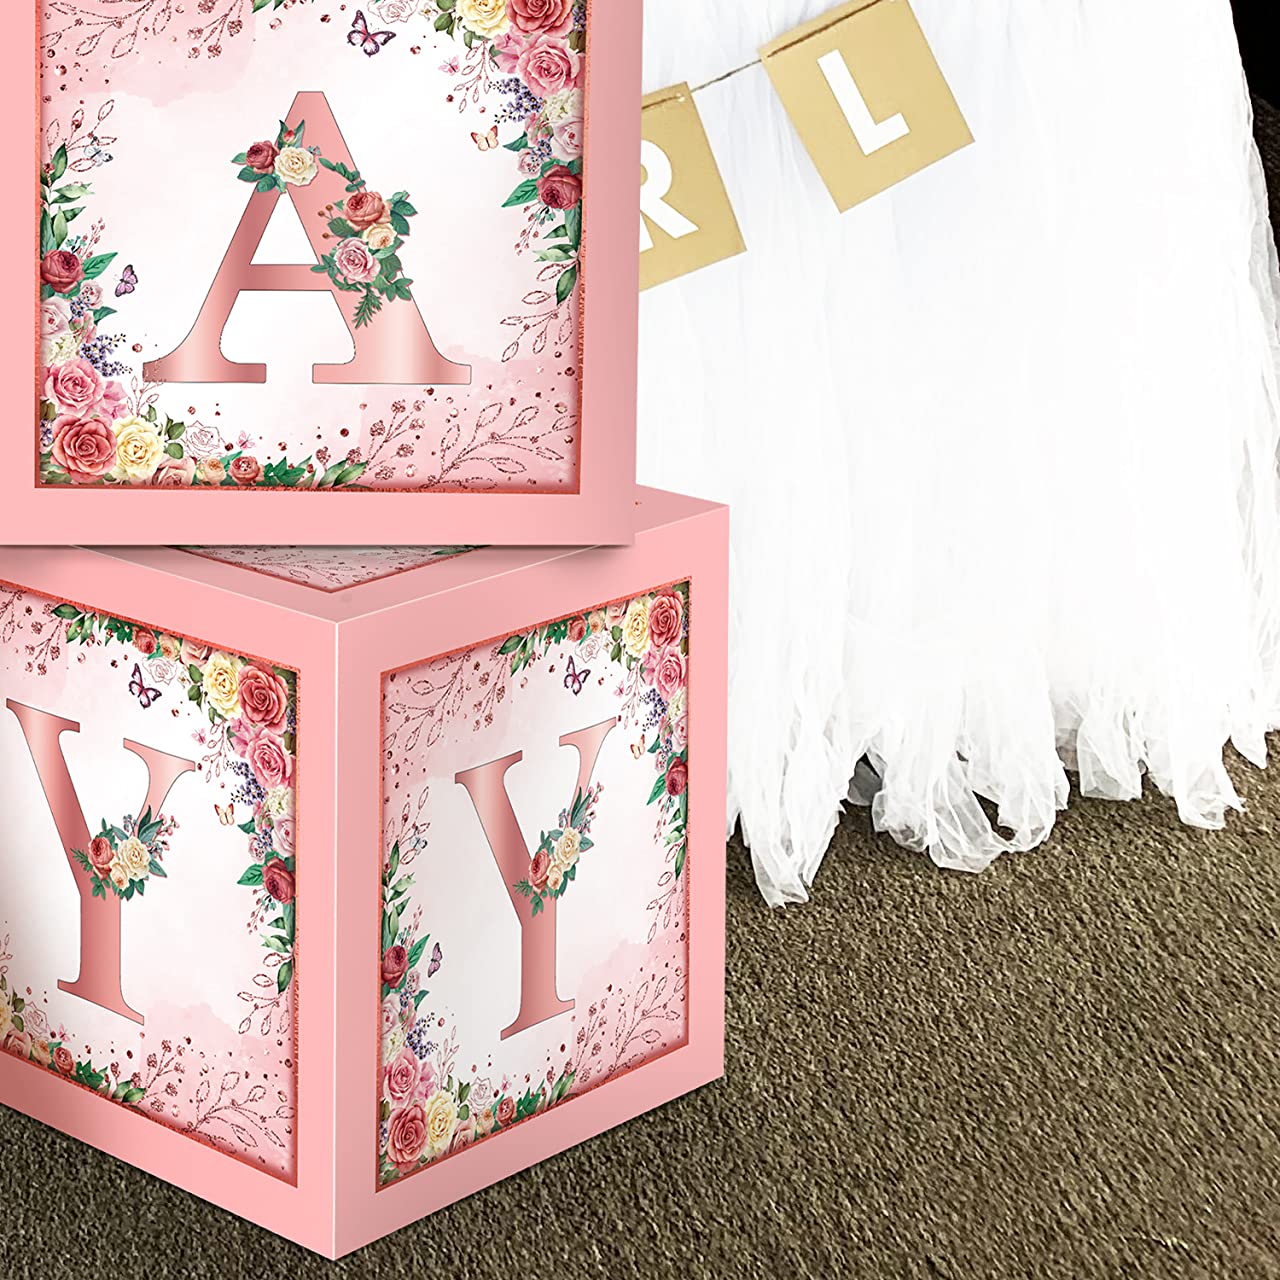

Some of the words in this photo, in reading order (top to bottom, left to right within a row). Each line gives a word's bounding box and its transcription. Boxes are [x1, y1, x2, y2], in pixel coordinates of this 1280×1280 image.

[142, 91, 471, 385] A
[6, 698, 196, 1026] Y
[455, 716, 617, 1041] Y
